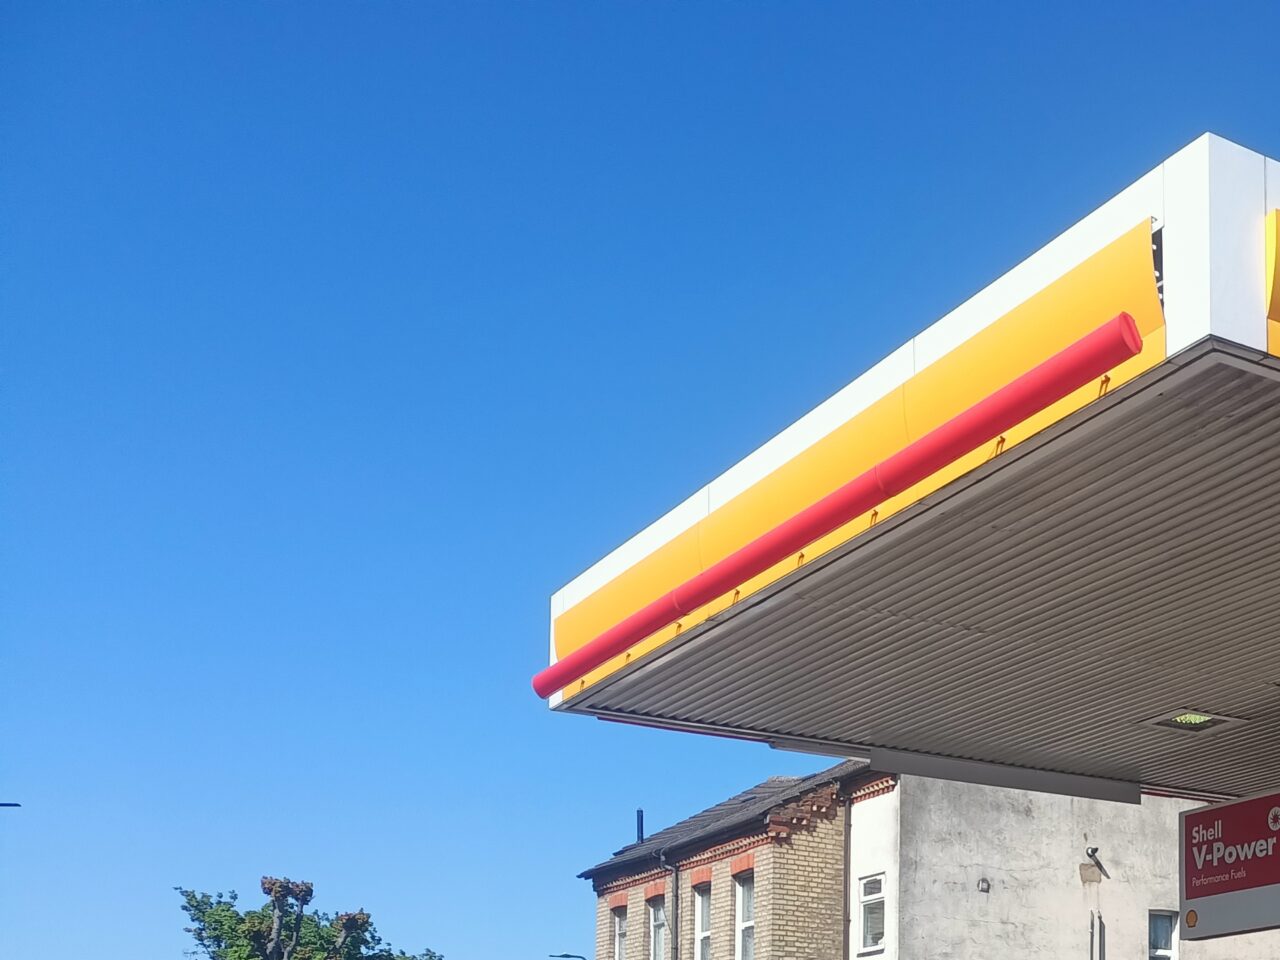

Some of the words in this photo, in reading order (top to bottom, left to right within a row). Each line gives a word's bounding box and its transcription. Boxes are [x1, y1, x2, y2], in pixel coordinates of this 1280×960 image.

[1192, 819, 1222, 844] Shell
[1192, 836, 1277, 870] V-Power
[1192, 872, 1230, 886] Performance
[1230, 867, 1247, 880] Fuels
